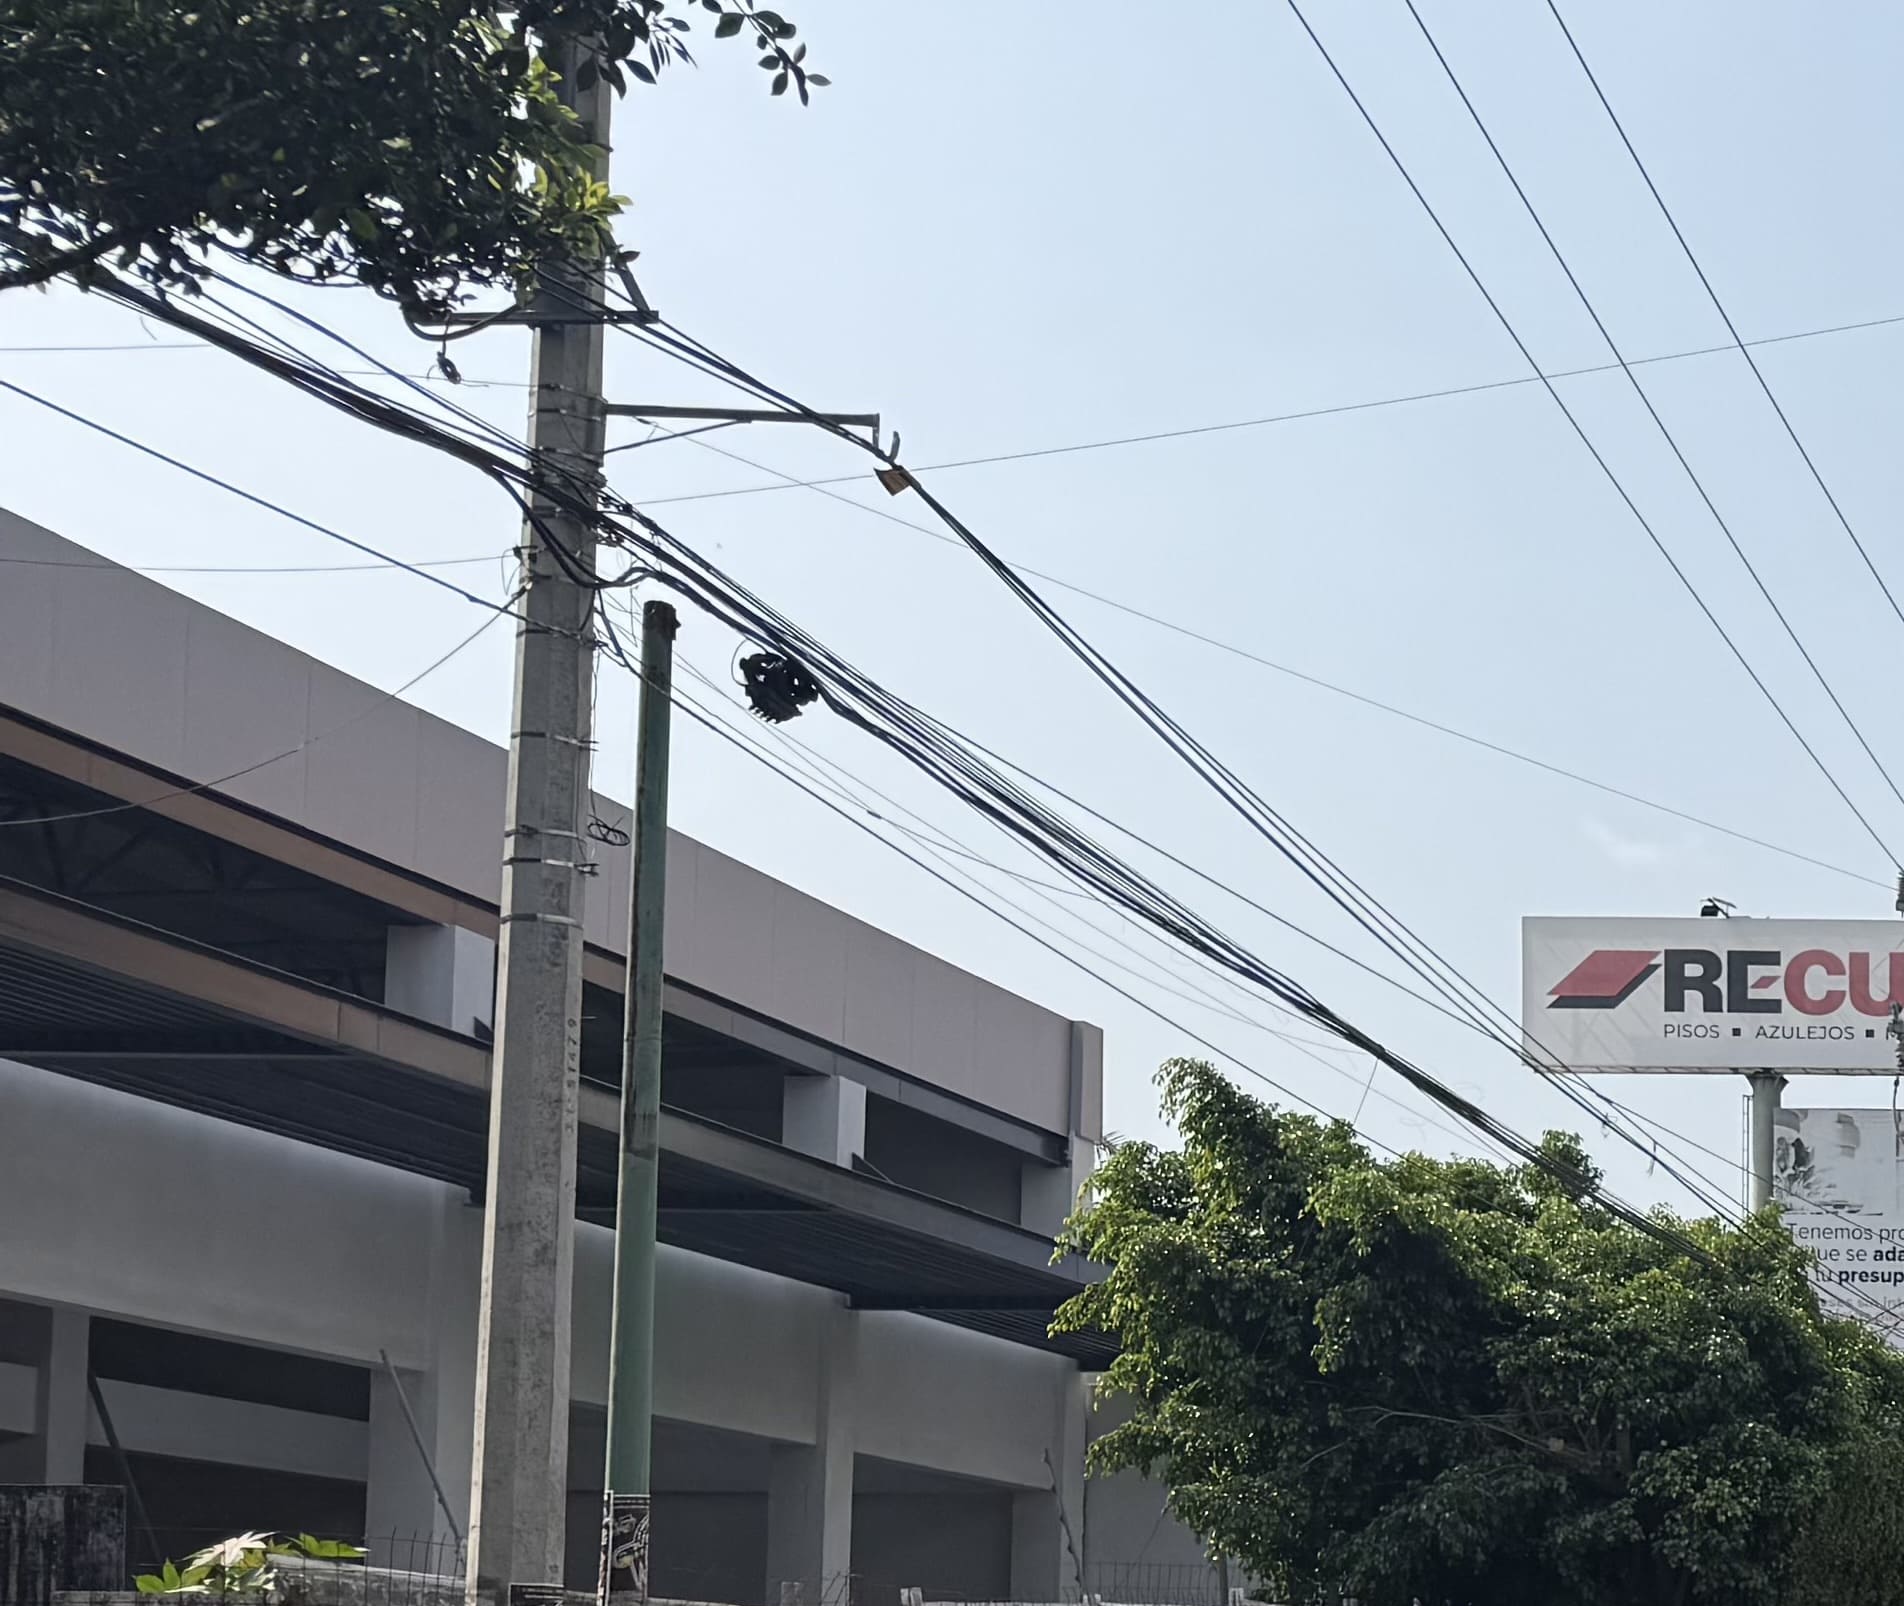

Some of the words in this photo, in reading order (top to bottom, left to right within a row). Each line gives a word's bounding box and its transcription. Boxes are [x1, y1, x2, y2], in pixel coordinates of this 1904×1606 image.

[1664, 1024, 1720, 1039] PISOS
[1755, 1026, 1855, 1040] AZULEJOS
[1786, 1223, 1873, 1241] Tenemos
[1847, 1249, 1867, 1262] se
